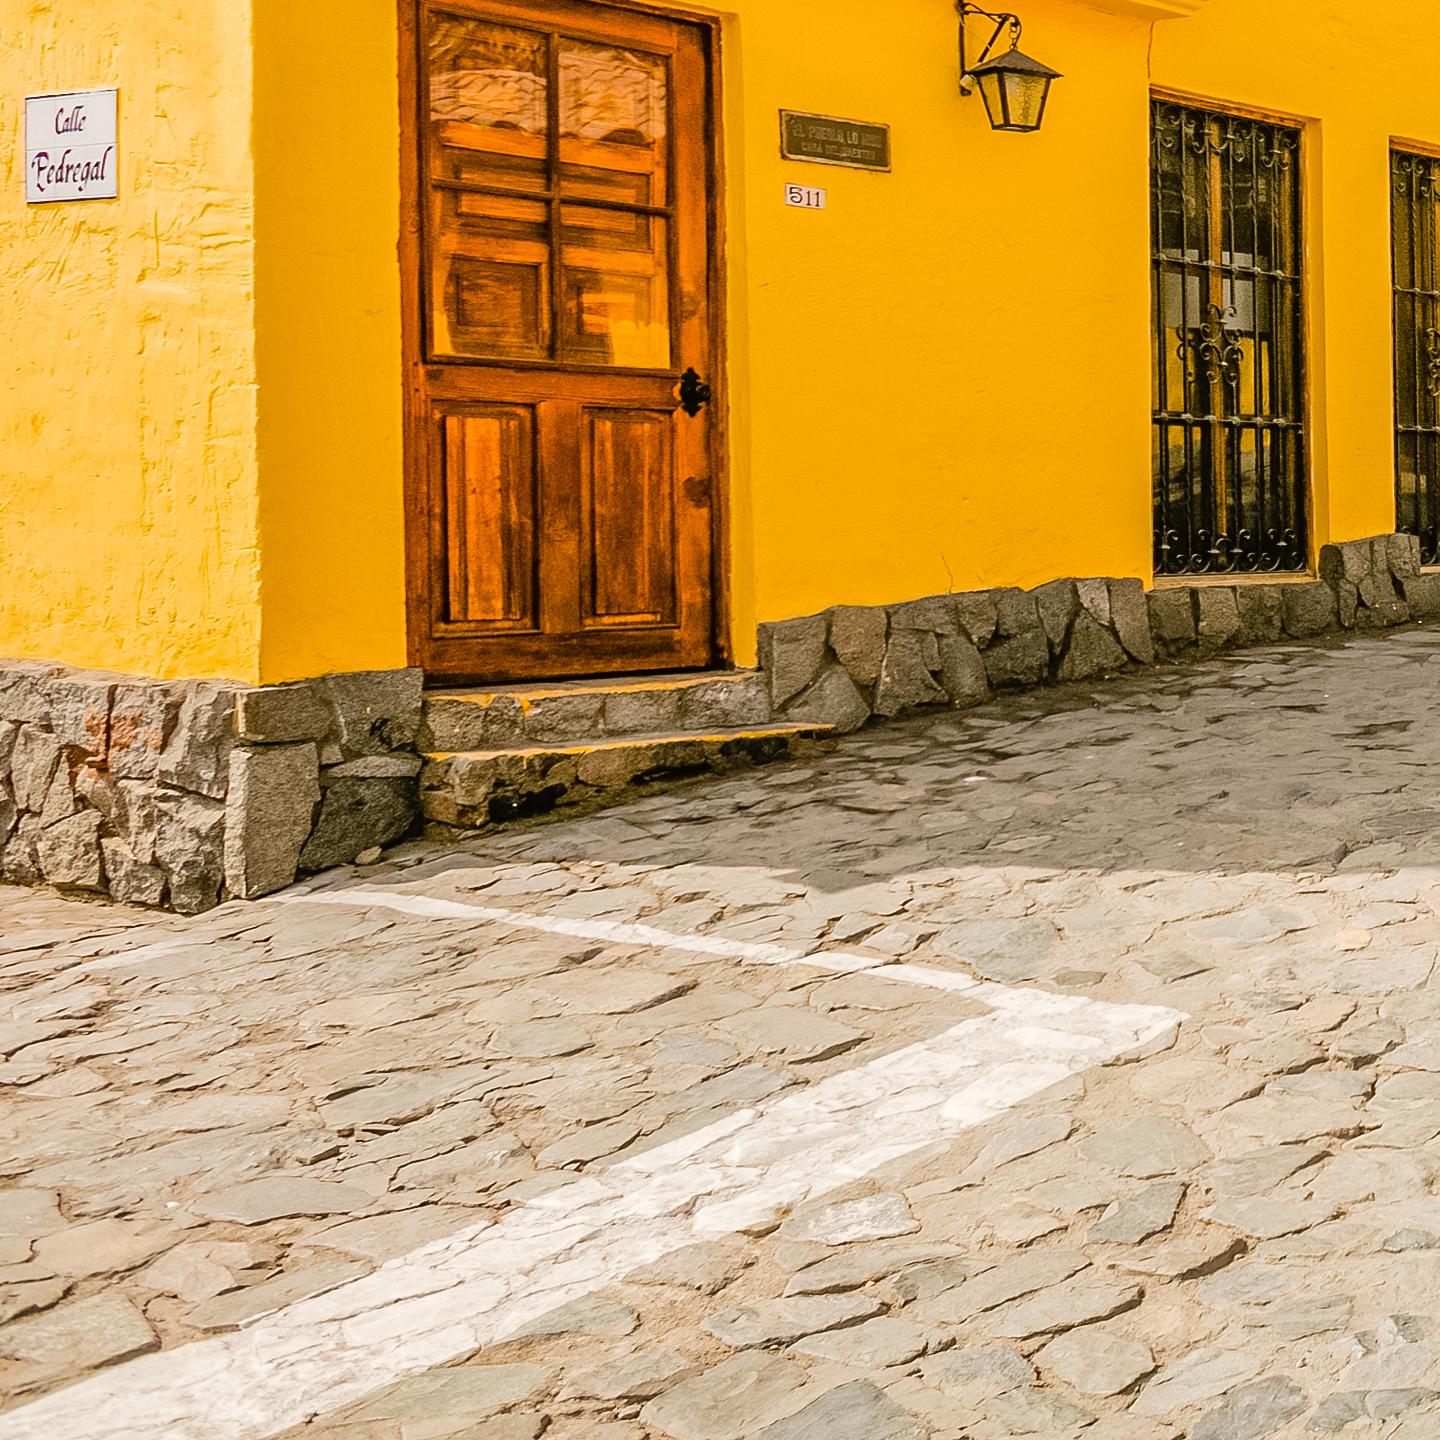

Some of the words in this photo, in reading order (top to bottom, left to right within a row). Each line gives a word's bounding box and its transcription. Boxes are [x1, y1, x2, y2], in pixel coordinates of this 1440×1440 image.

[55, 105, 87, 135] Calle
[31, 145, 114, 193] Pedregal
[789, 186, 821, 208] 511
